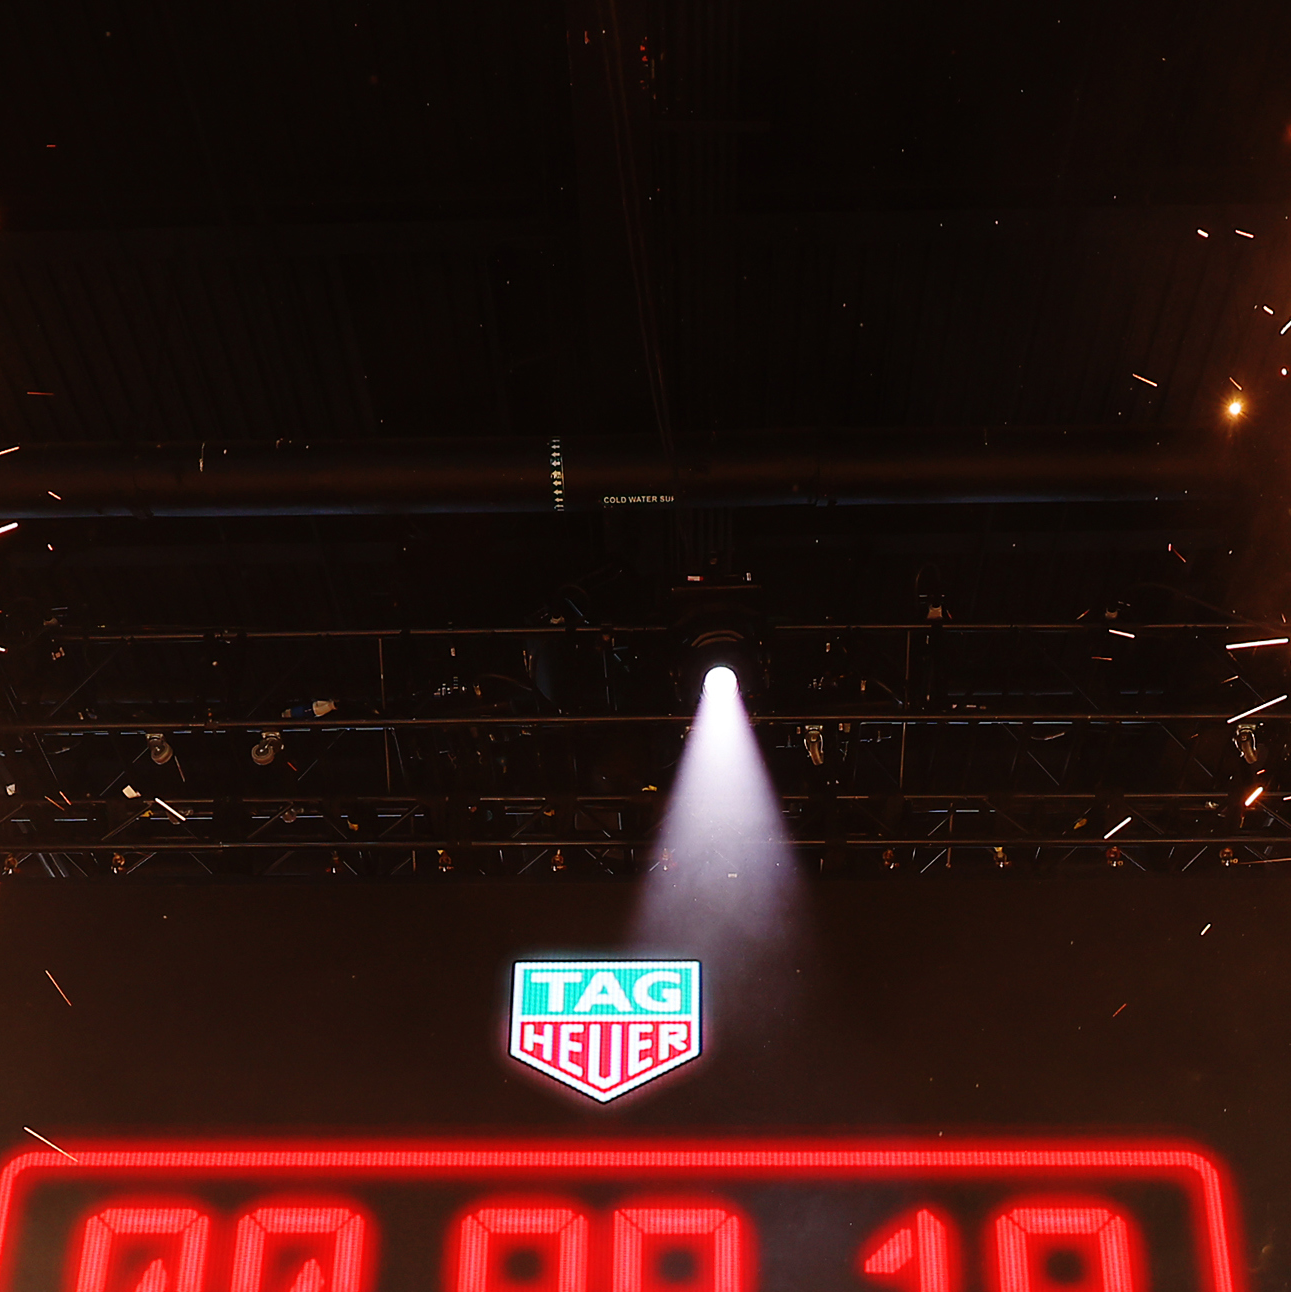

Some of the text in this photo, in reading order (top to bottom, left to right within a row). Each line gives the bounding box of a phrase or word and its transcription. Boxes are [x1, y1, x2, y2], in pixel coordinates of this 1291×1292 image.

[603, 496, 627, 504] COLD
[628, 495, 658, 503] WATER
[530, 970, 682, 1013] TAG
[522, 1024, 688, 1090] HEUER
